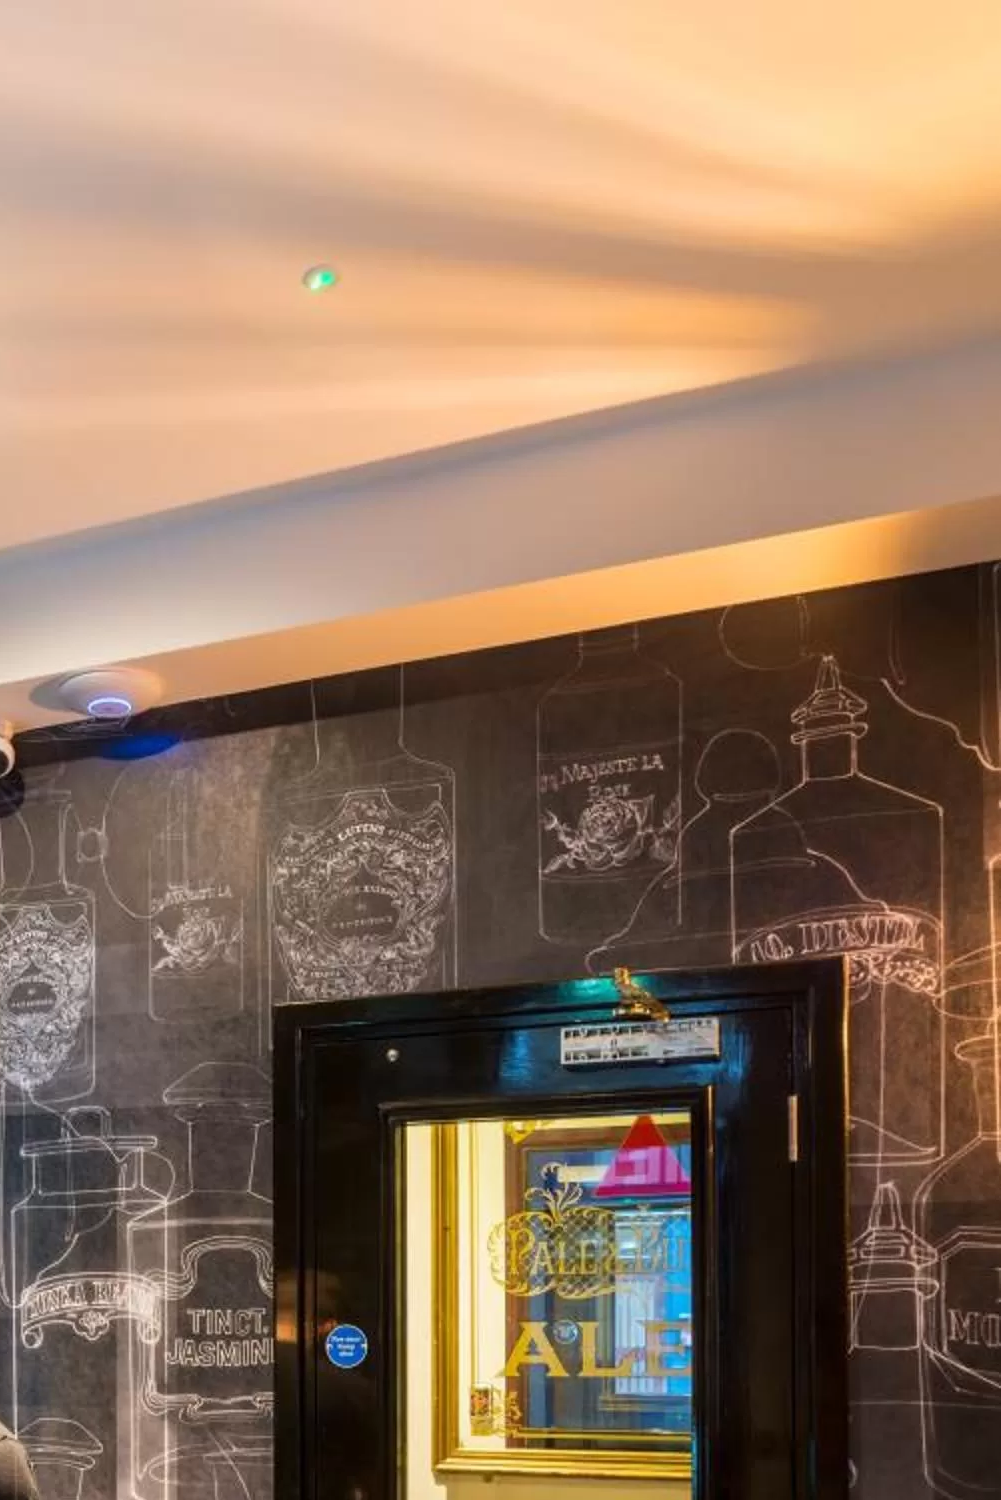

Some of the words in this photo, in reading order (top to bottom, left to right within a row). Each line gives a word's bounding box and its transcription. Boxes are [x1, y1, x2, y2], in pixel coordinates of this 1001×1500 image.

[506, 1226, 599, 1276] PALE
[186, 1306, 269, 1336] TINCT.
[495, 1320, 691, 1378] ALE
